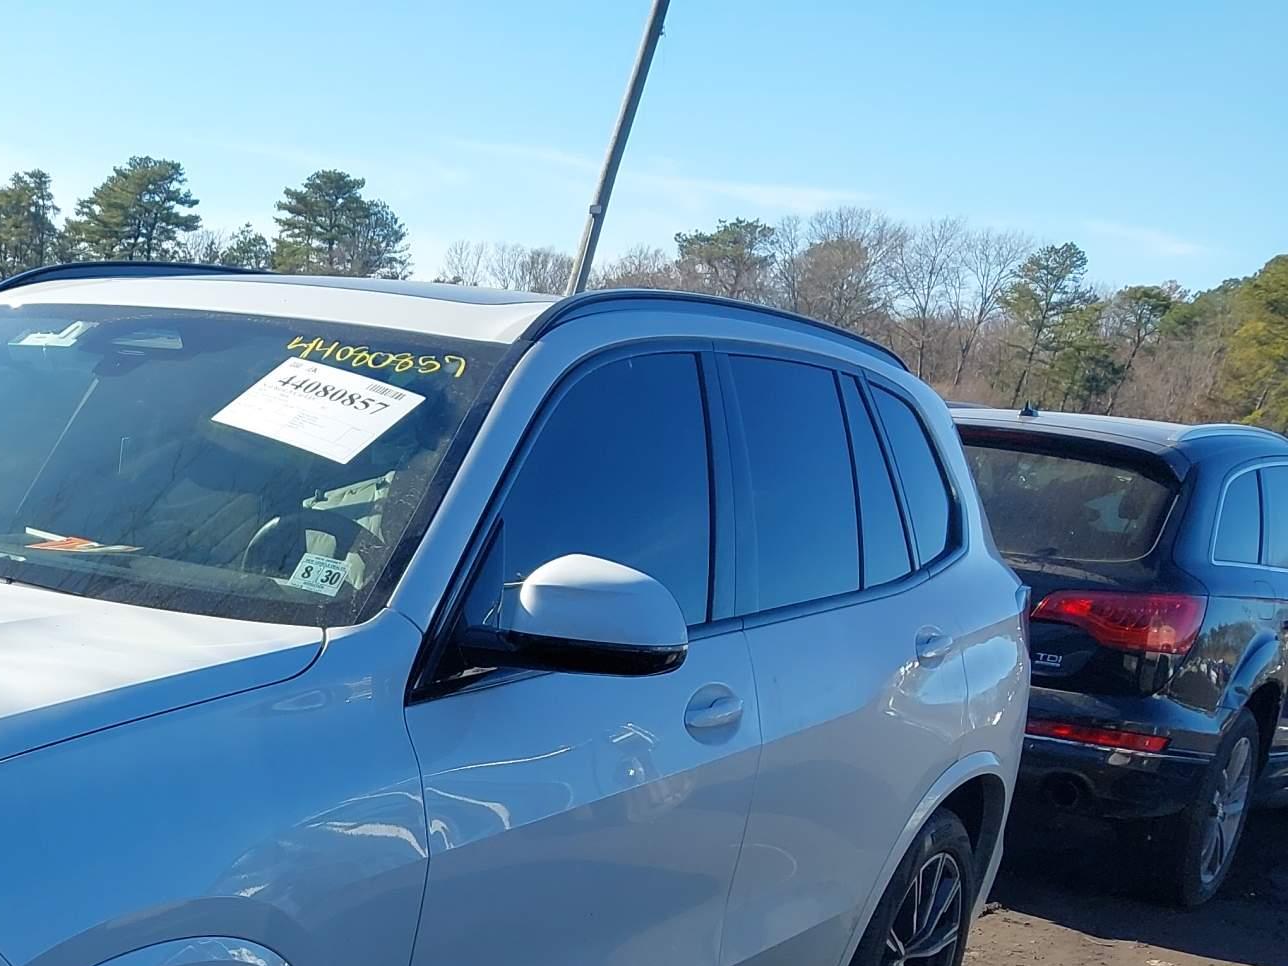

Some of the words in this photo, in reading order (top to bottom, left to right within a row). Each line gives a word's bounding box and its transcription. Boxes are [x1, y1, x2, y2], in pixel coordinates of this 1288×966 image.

[287, 336, 466, 378] 44080857
[278, 375, 391, 415] 44080857
[301, 565, 314, 579] 8
[320, 569, 342, 586] 30
[1035, 652, 1063, 664] TDI
